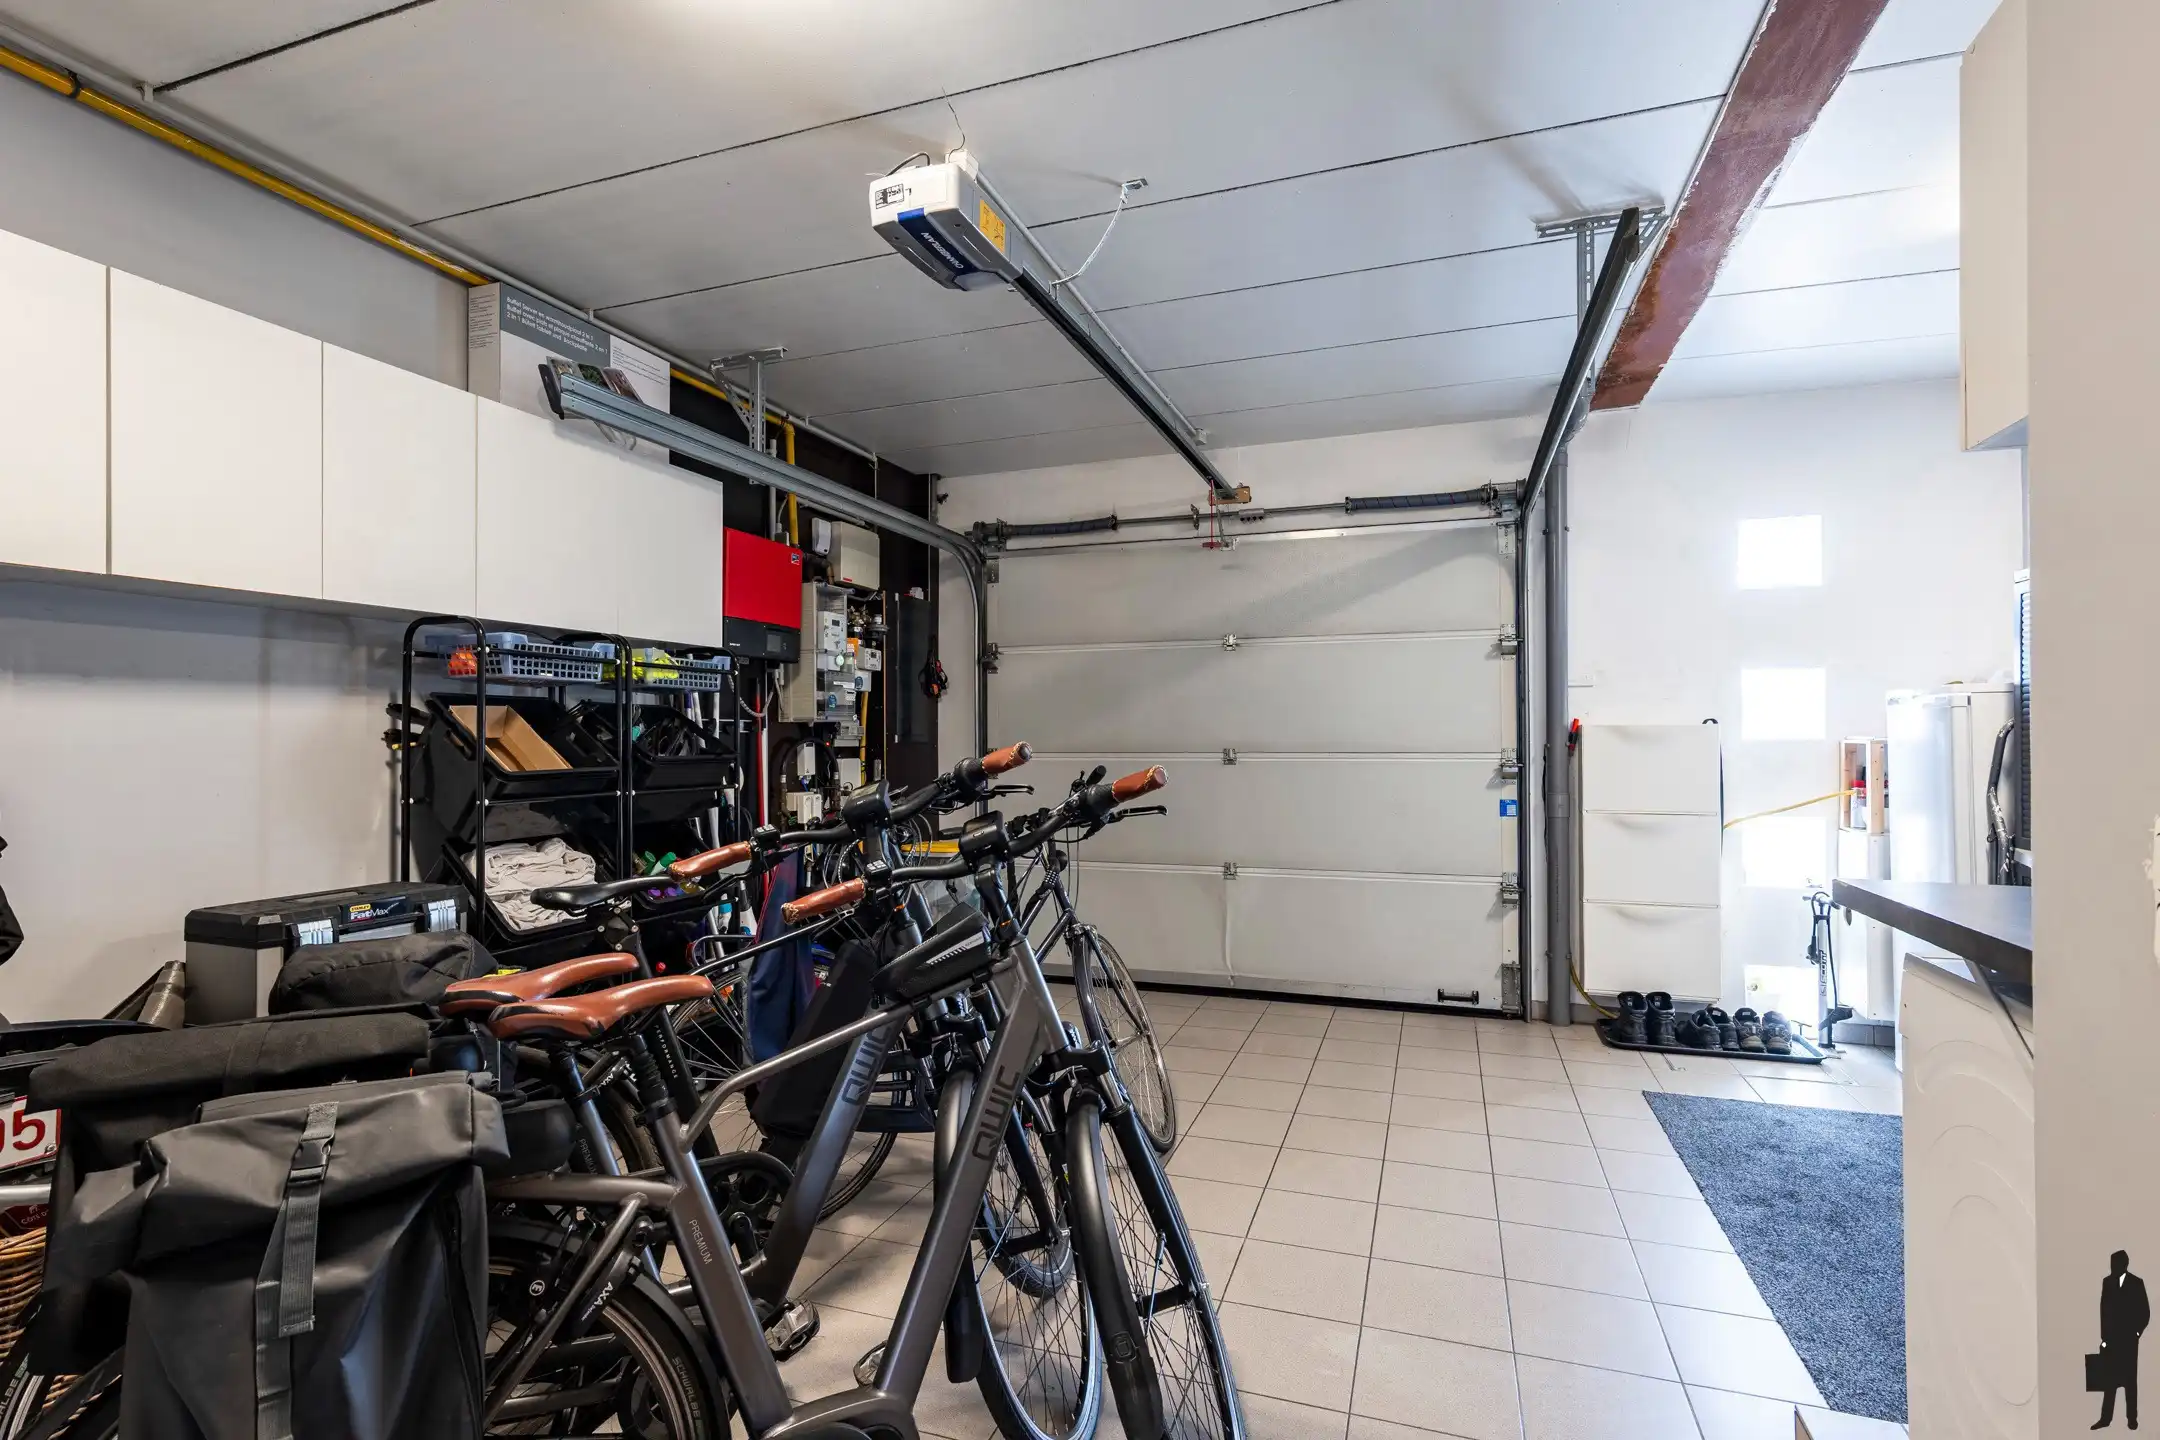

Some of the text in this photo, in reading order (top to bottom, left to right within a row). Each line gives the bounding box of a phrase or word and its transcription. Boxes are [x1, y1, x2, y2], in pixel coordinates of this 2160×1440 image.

[921, 232, 965, 269] CHAMBERLAIN
[507, 296, 521, 308] Buffet
[351, 908, 389, 920] FatMax
[653, 1024, 678, 1079] PERFORMANCE
[972, 1065, 1021, 1161] QWIC
[688, 1219, 713, 1266] PREMIUM
[593, 1281, 615, 1308] AXA
[671, 1356, 701, 1419] SCHWALBE
